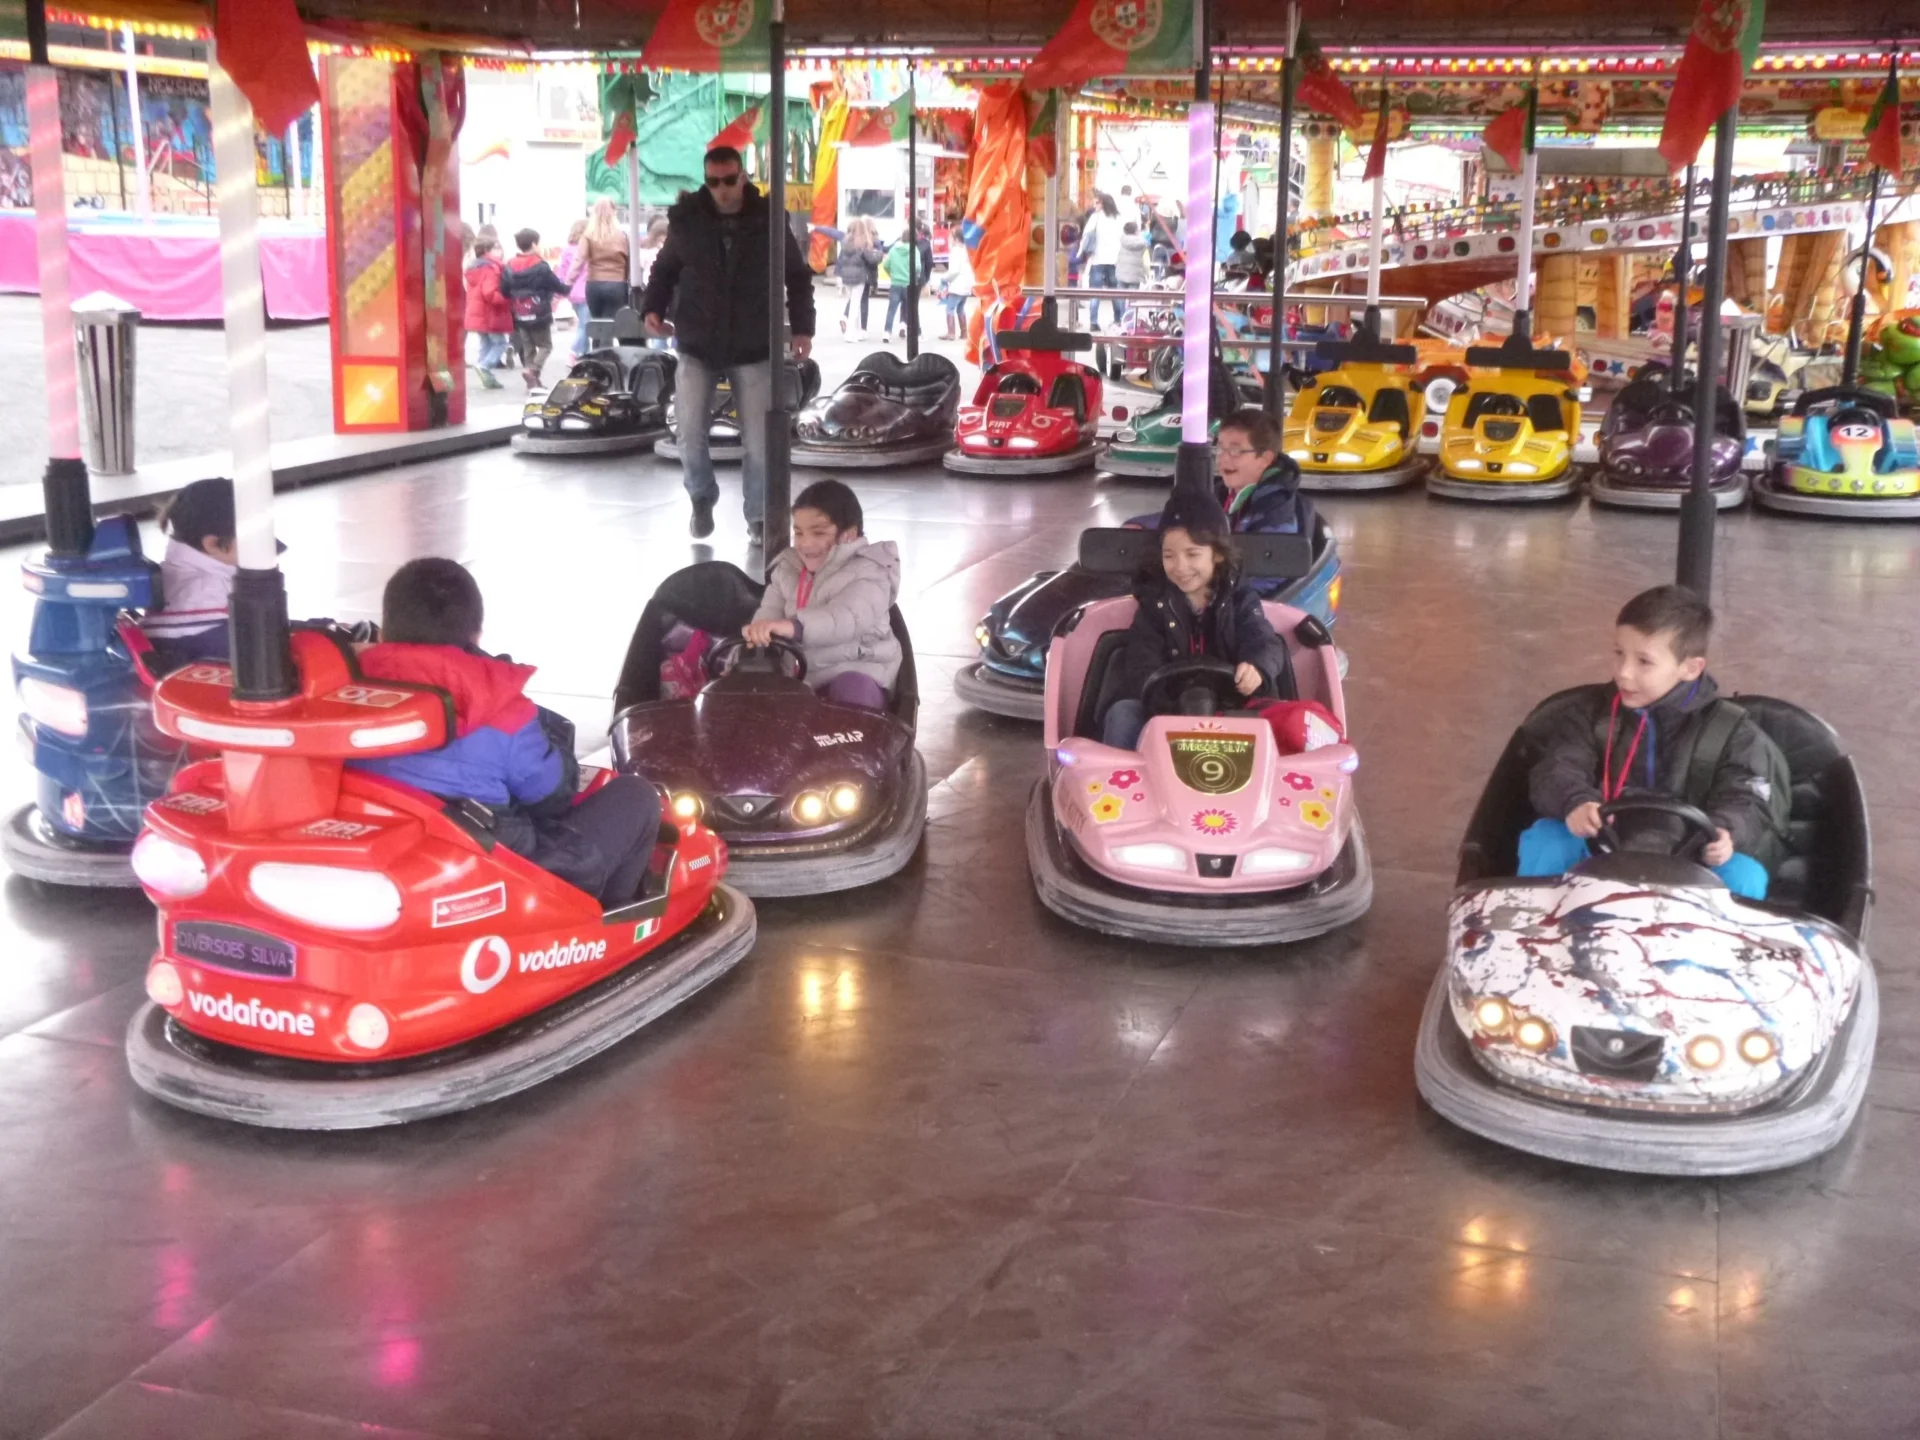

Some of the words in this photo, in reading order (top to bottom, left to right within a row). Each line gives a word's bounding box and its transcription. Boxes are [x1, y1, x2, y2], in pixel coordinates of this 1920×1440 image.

[988, 421, 1012, 429] FIAT
[1842, 427, 1868, 437] 12
[1222, 743, 1247, 753] SILVA
[1201, 760, 1224, 782] 9
[308, 818, 381, 836] FIAT
[251, 946, 288, 968] SILVA
[519, 937, 607, 973] vodafone
[188, 989, 315, 1036] vodafone
